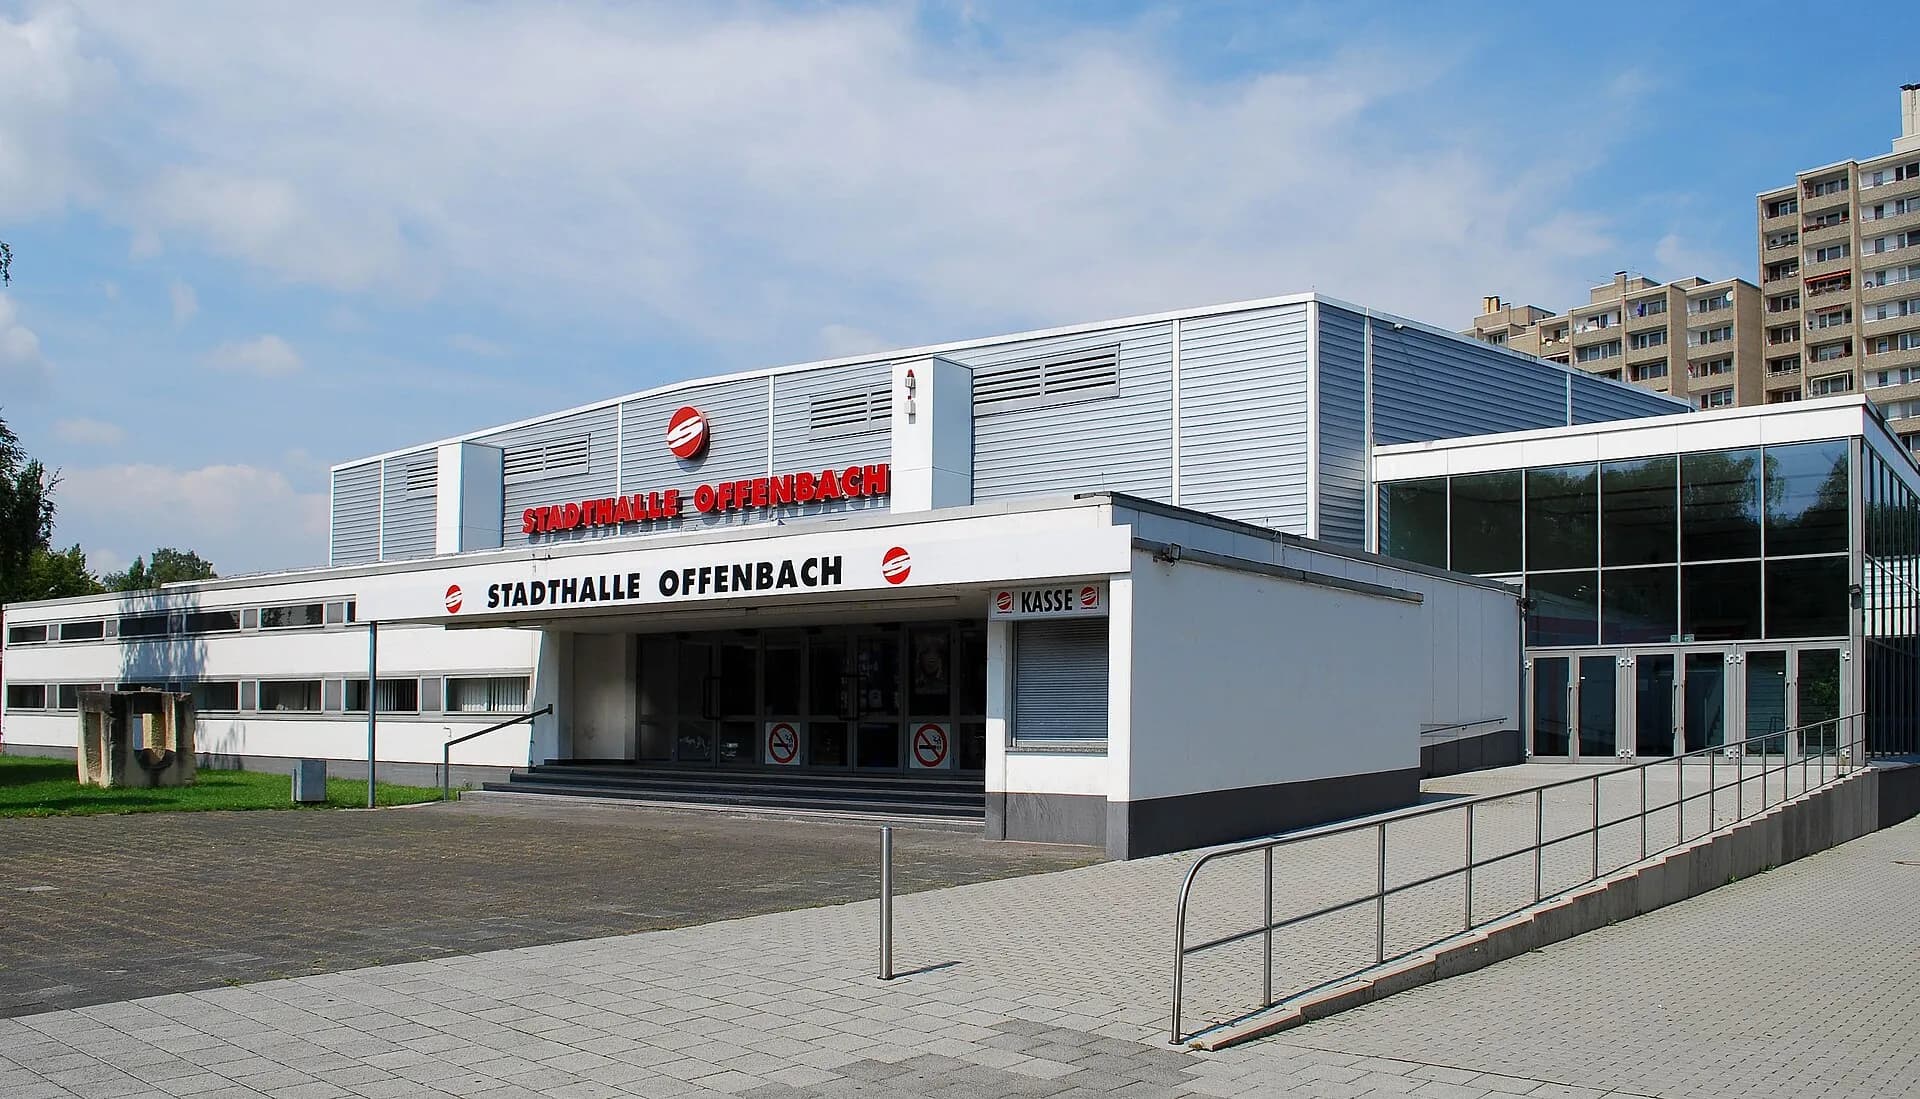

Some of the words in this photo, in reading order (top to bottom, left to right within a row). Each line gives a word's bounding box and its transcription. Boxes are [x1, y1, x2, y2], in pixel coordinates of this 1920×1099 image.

[522, 489, 680, 534] STADTHALLE
[694, 463, 890, 514] OFFENBACH
[487, 572, 640, 608] STADTHALLE
[658, 555, 843, 597] OFFENBACH
[1021, 588, 1073, 613] KASSE
